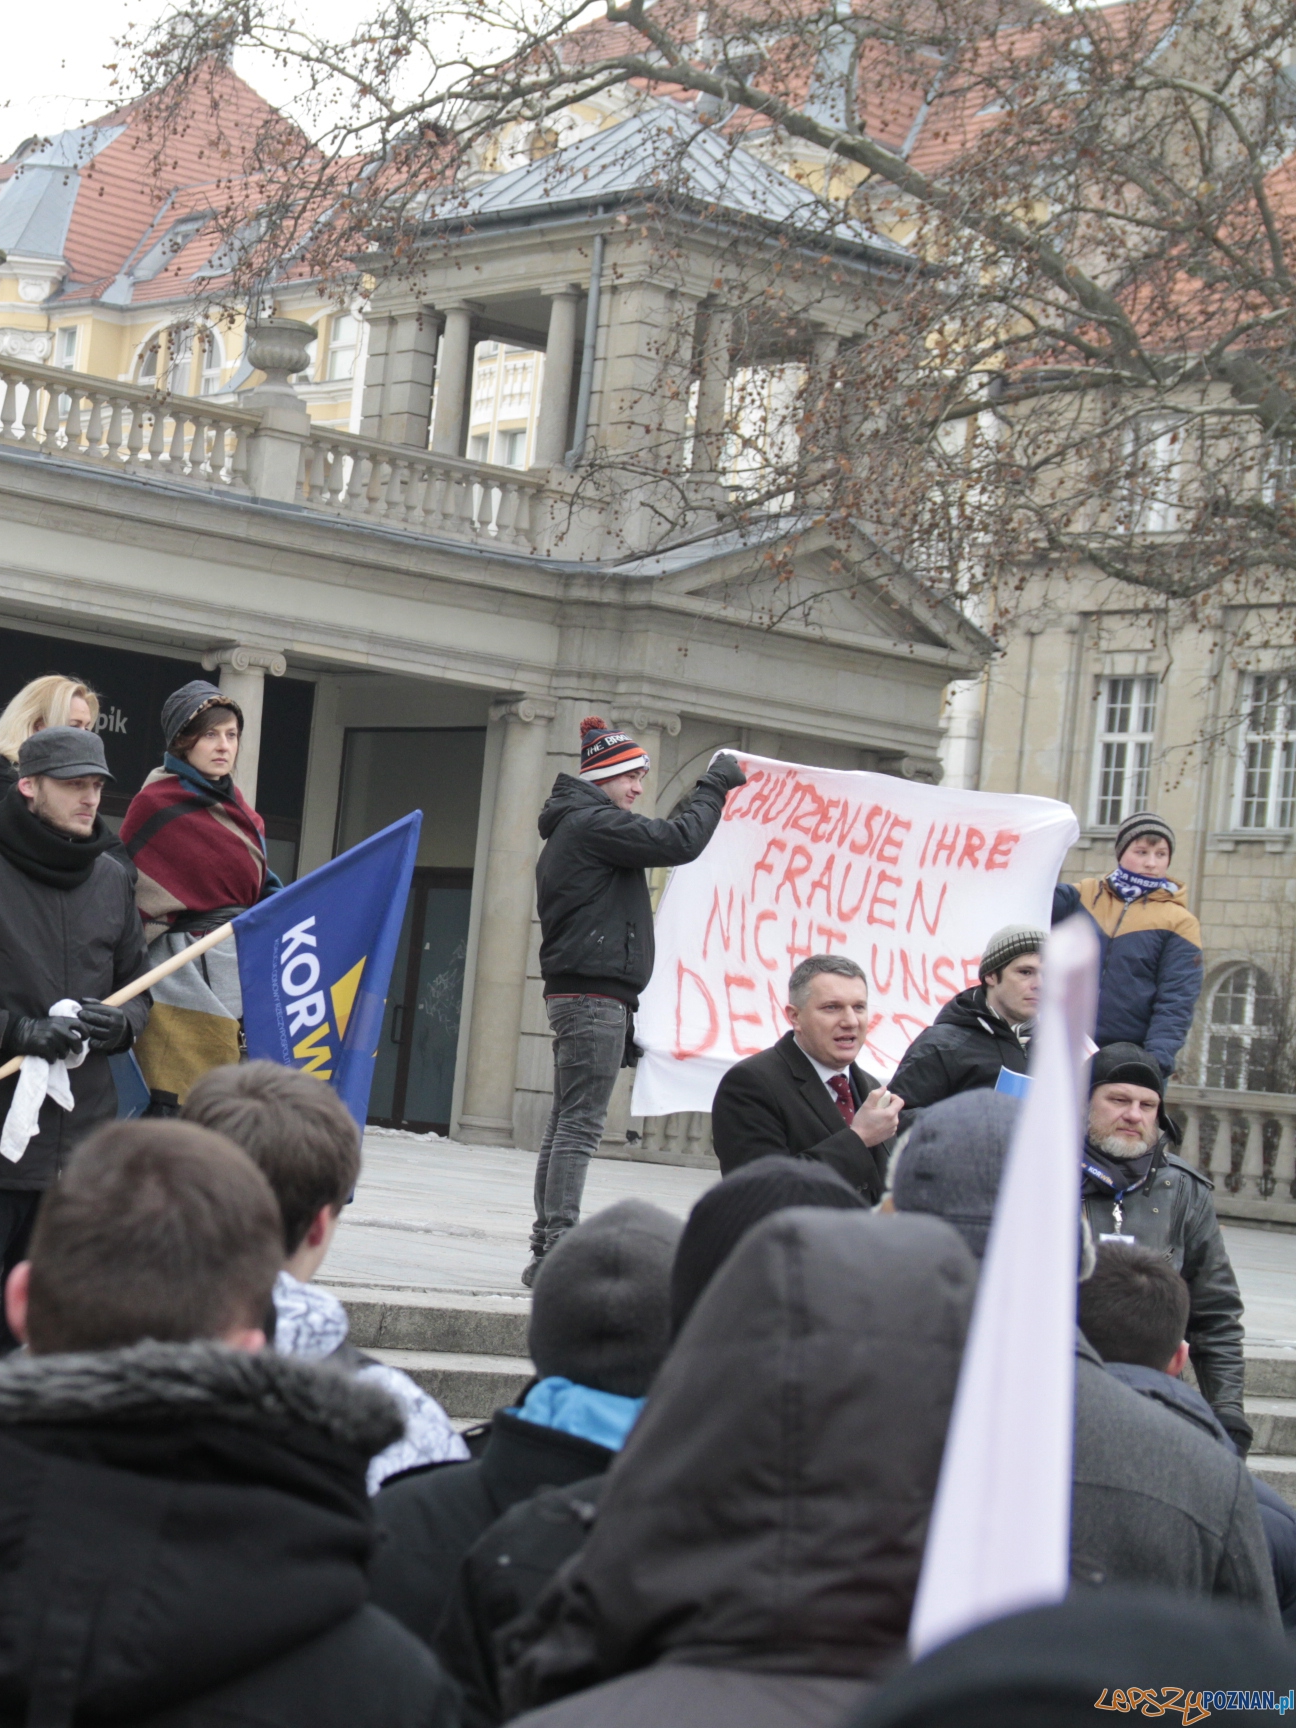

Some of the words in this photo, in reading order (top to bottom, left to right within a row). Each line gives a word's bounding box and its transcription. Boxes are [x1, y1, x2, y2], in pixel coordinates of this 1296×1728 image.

[94, 705, 129, 734] pik
[586, 741, 604, 756] THE
[919, 821, 1020, 871] IHRE
[750, 838, 948, 936] FRAUEN
[702, 885, 847, 974] NICHT
[870, 942, 982, 1005] UNSE
[280, 915, 332, 1081] KORW
[275, 1002, 291, 1066] RZECZYPOSPOLIT
